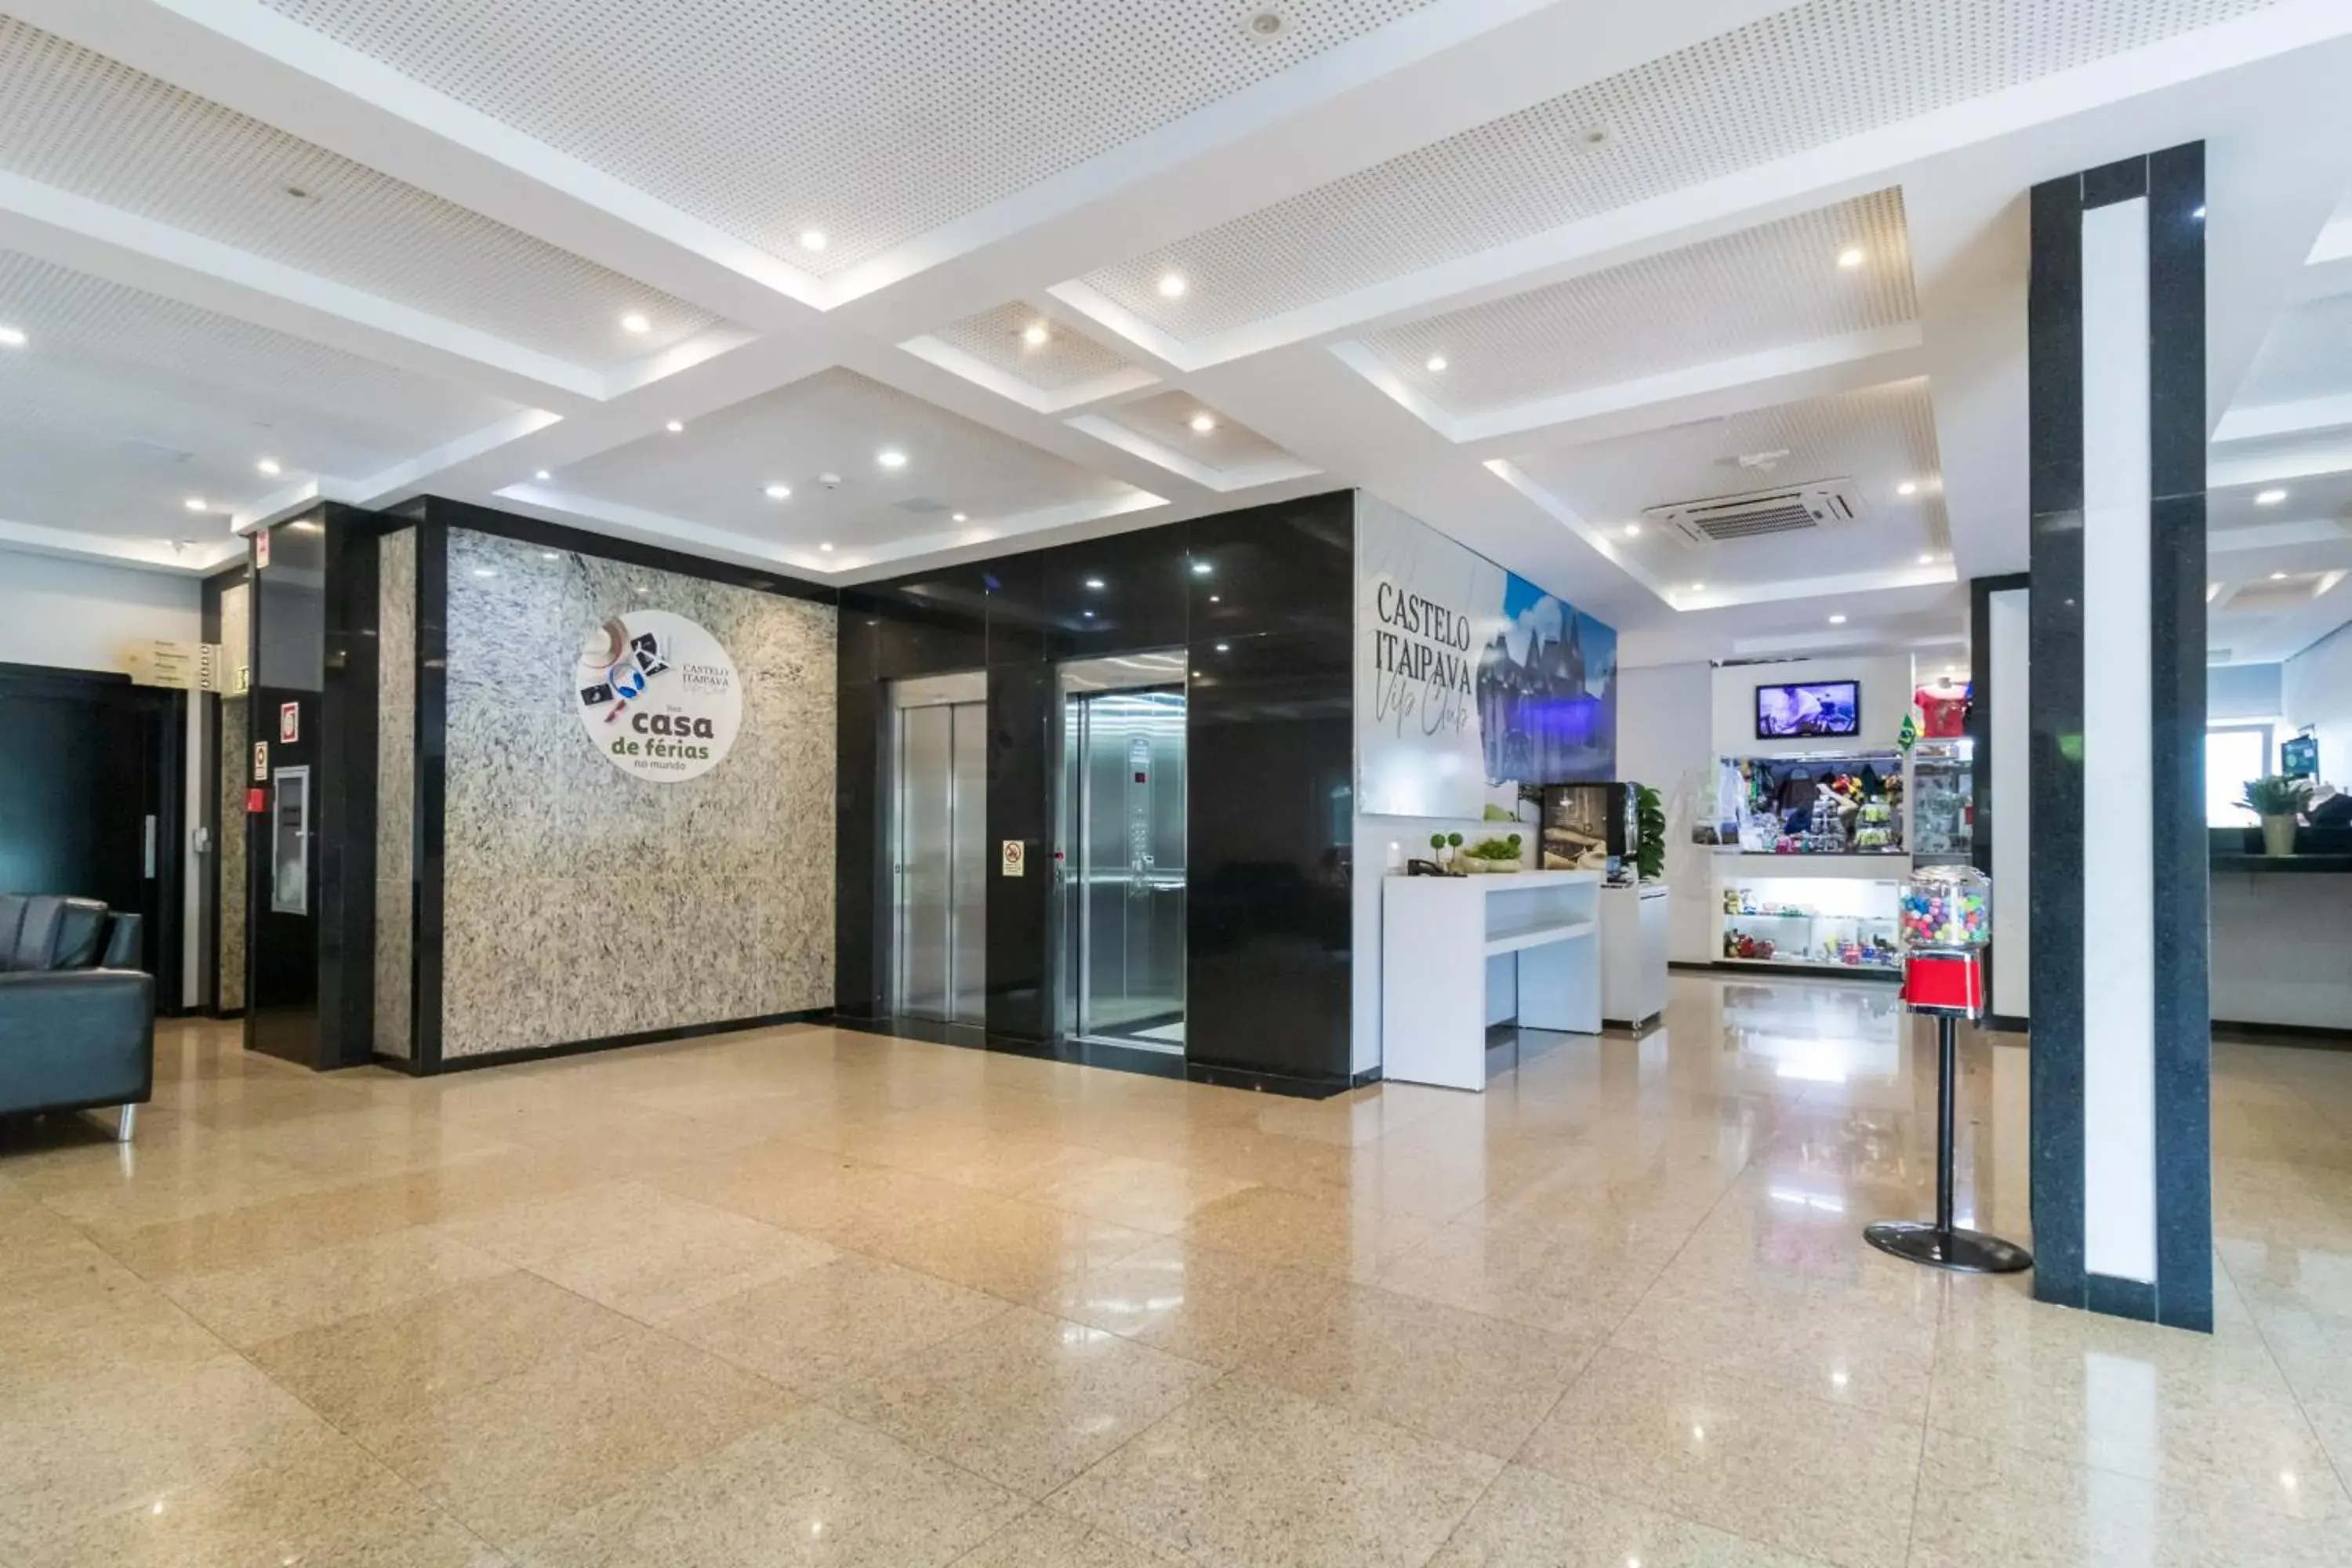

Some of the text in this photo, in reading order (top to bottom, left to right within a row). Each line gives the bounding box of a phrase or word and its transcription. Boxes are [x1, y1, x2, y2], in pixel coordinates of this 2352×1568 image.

[1377, 582, 1470, 652] CASTELO
[1375, 630, 1472, 695] ITAIPAVA
[683, 673, 729, 686] ITAIPAVA
[631, 713, 713, 739] casa
[612, 737, 710, 759] de férias
[650, 760, 686, 770] mundo
